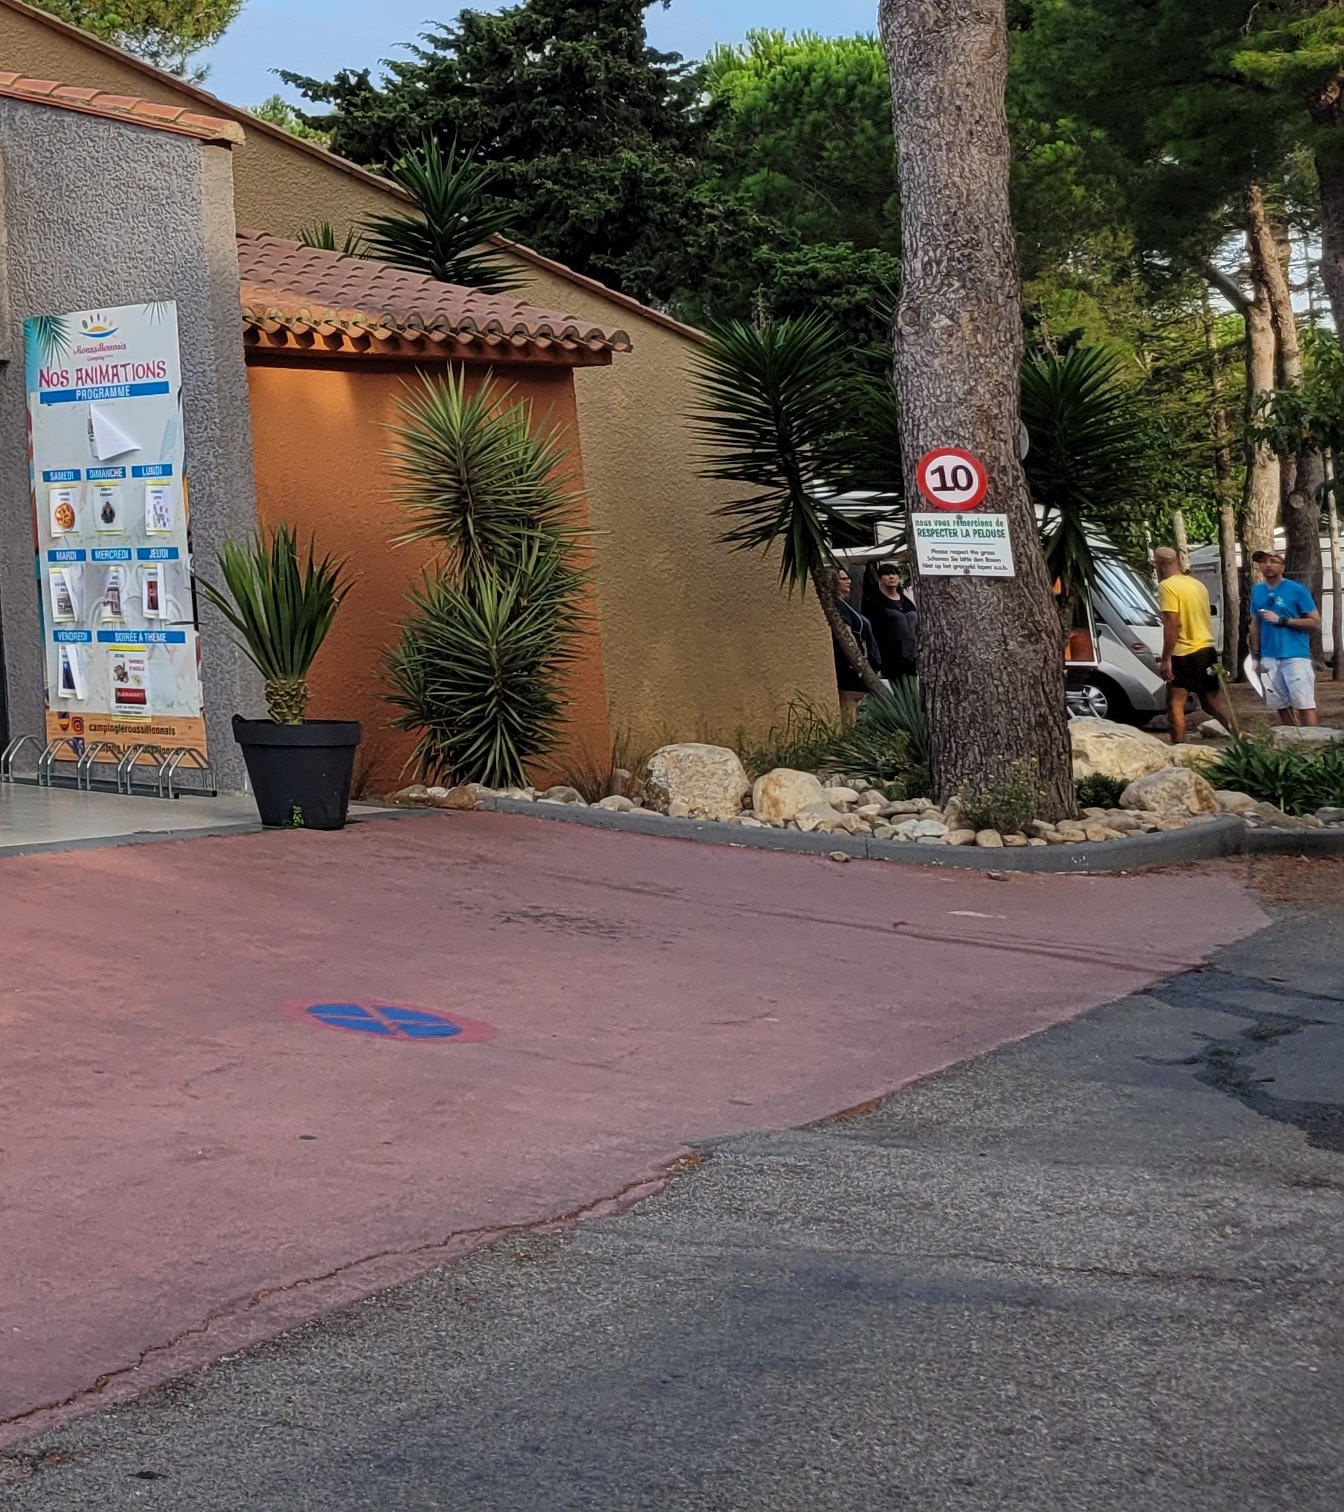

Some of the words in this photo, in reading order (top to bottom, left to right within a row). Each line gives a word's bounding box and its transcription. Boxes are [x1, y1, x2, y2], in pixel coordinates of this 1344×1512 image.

[39, 366, 70, 388] NOS
[75, 360, 167, 387] ANIMATIONS
[76, 385, 131, 400] PROGRAMME
[50, 471, 74, 481] SAMEDI
[89, 467, 124, 478] DIMANCHE
[142, 465, 163, 476] LUNDI
[930, 465, 974, 492] 10
[915, 519, 932, 527] nous
[934, 519, 951, 527] vous
[953, 517, 993, 527] remercions
[995, 517, 1004, 527] de
[917, 528, 958, 538] RESPECTER
[961, 529, 971, 538] LA
[973, 529, 1006, 539] PELOUSE
[56, 551, 77, 561] MARDI
[94, 549, 130, 560] MERCREDI
[148, 548, 169, 559] JEUDI
[57, 631, 88, 642] VENDREDI
[114, 630, 138, 642] SOIRÉE
